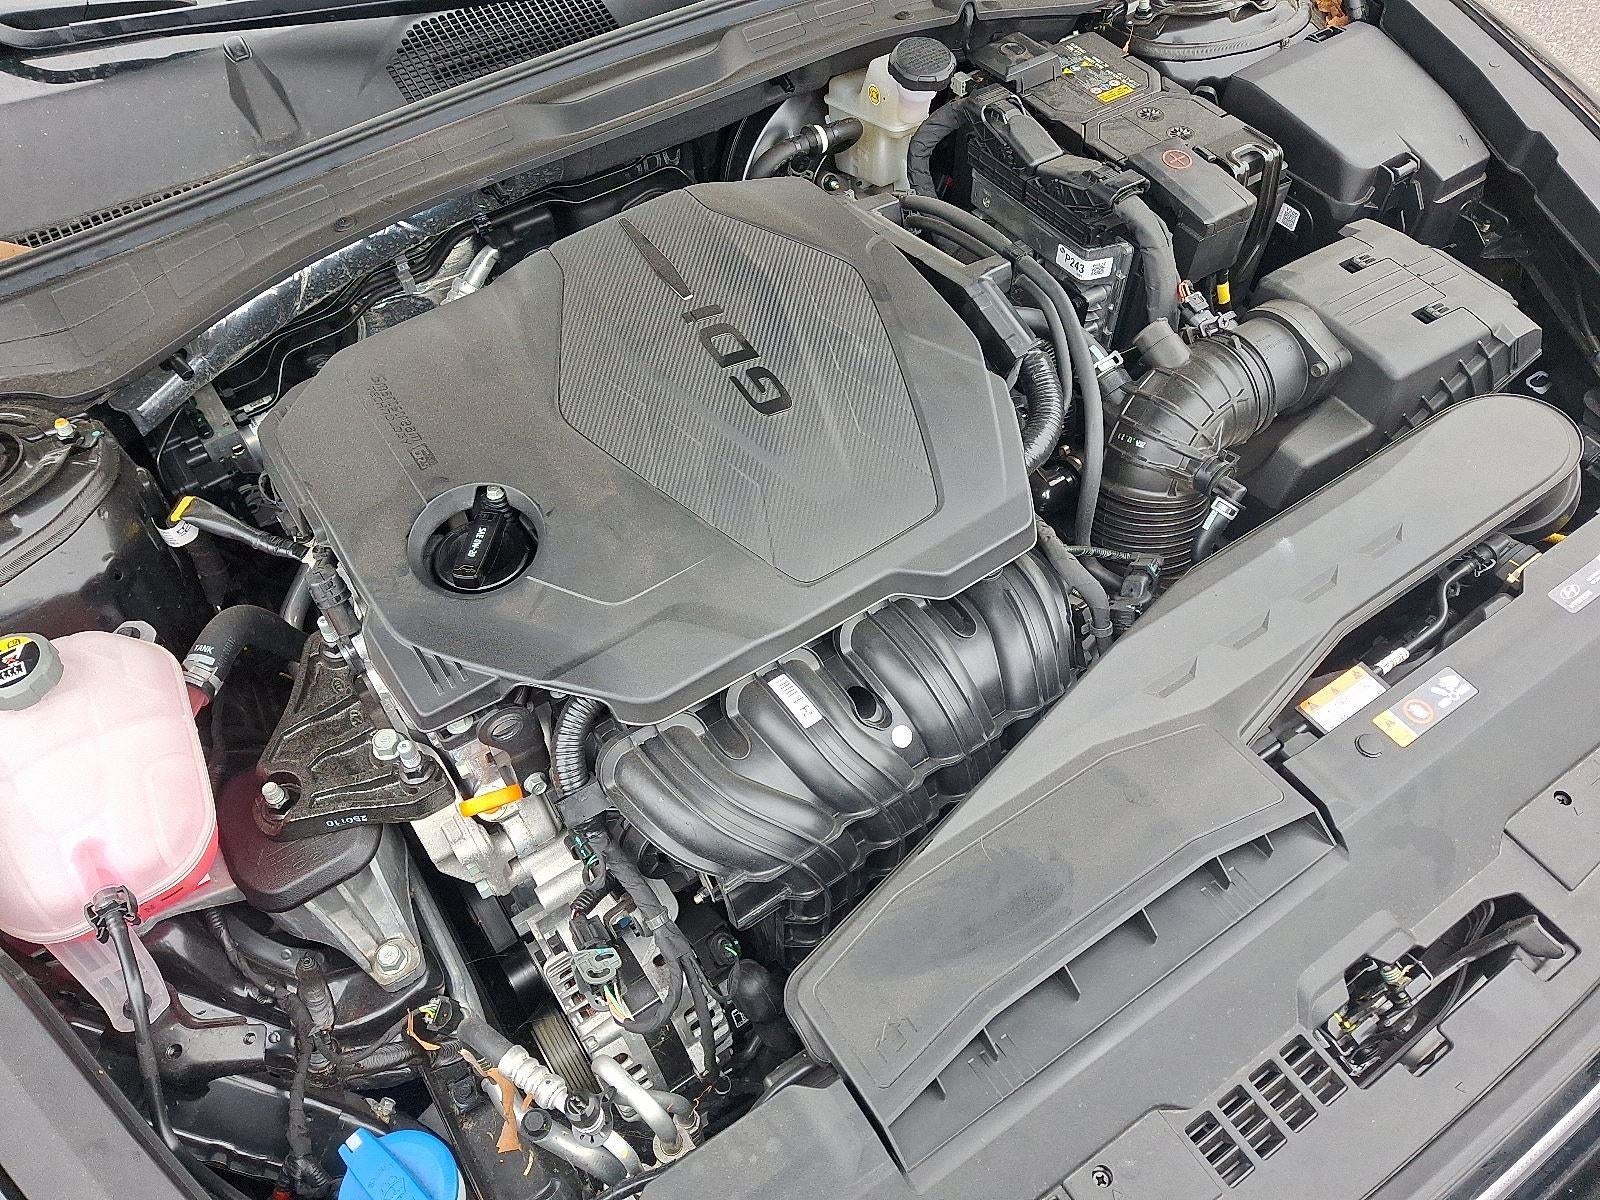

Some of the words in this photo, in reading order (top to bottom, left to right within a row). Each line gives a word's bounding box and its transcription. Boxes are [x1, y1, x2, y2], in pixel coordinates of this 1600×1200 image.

[1064, 253, 1085, 274] P243
[475, 527, 487, 539] SAE
[194, 643, 215, 655] TANK
